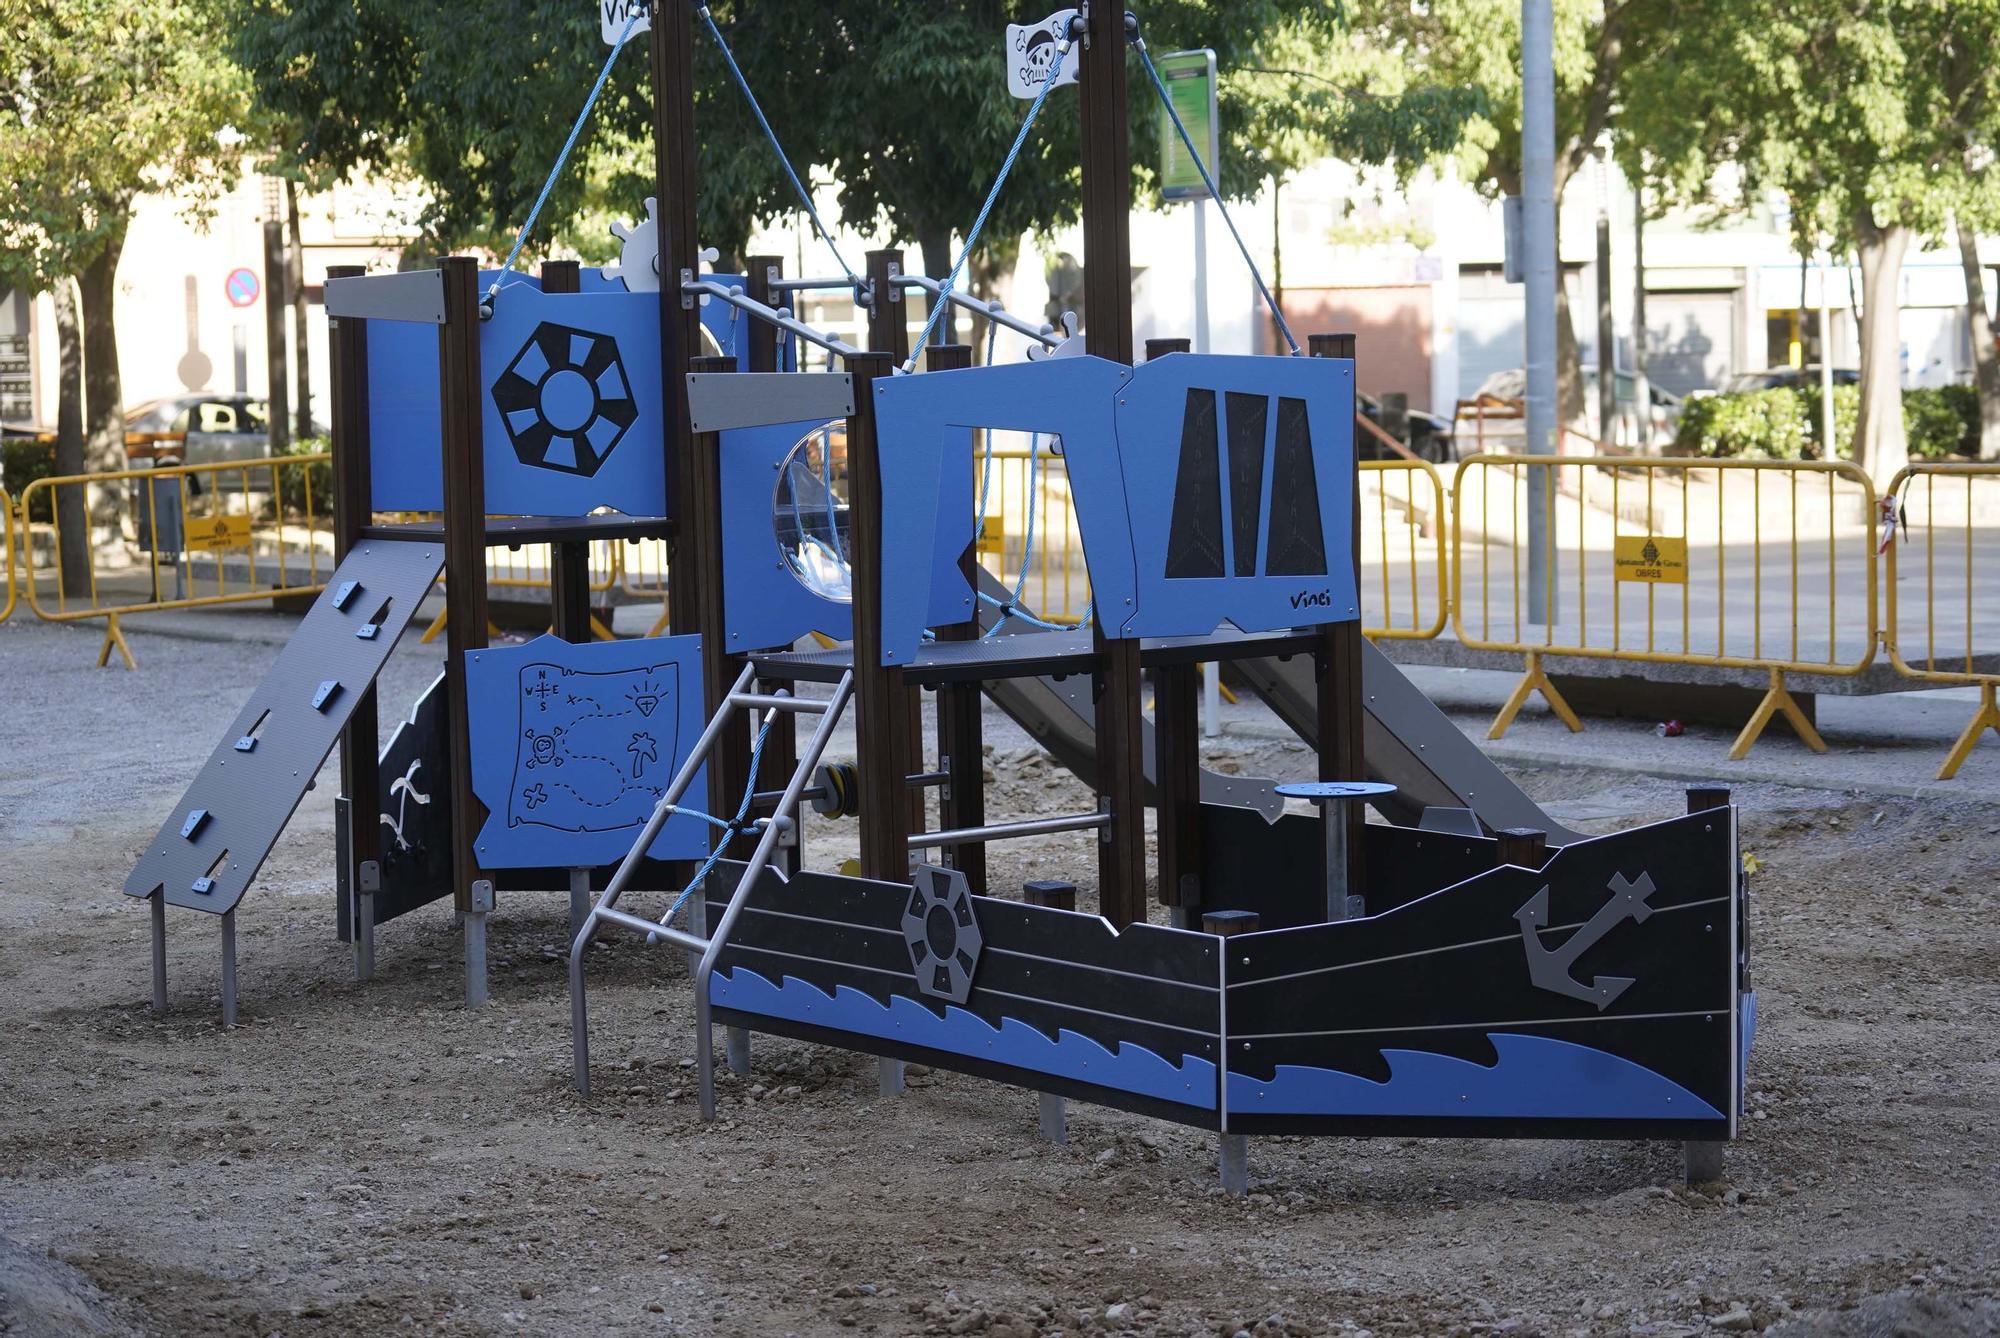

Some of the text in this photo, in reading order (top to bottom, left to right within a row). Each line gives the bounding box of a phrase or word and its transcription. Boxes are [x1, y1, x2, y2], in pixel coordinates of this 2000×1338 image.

[1635, 568, 1662, 579] OBRES
[1290, 589, 1331, 610] Vinci
[539, 670, 546, 680] N
[525, 685, 559, 696] W E
[540, 702, 546, 711] S
